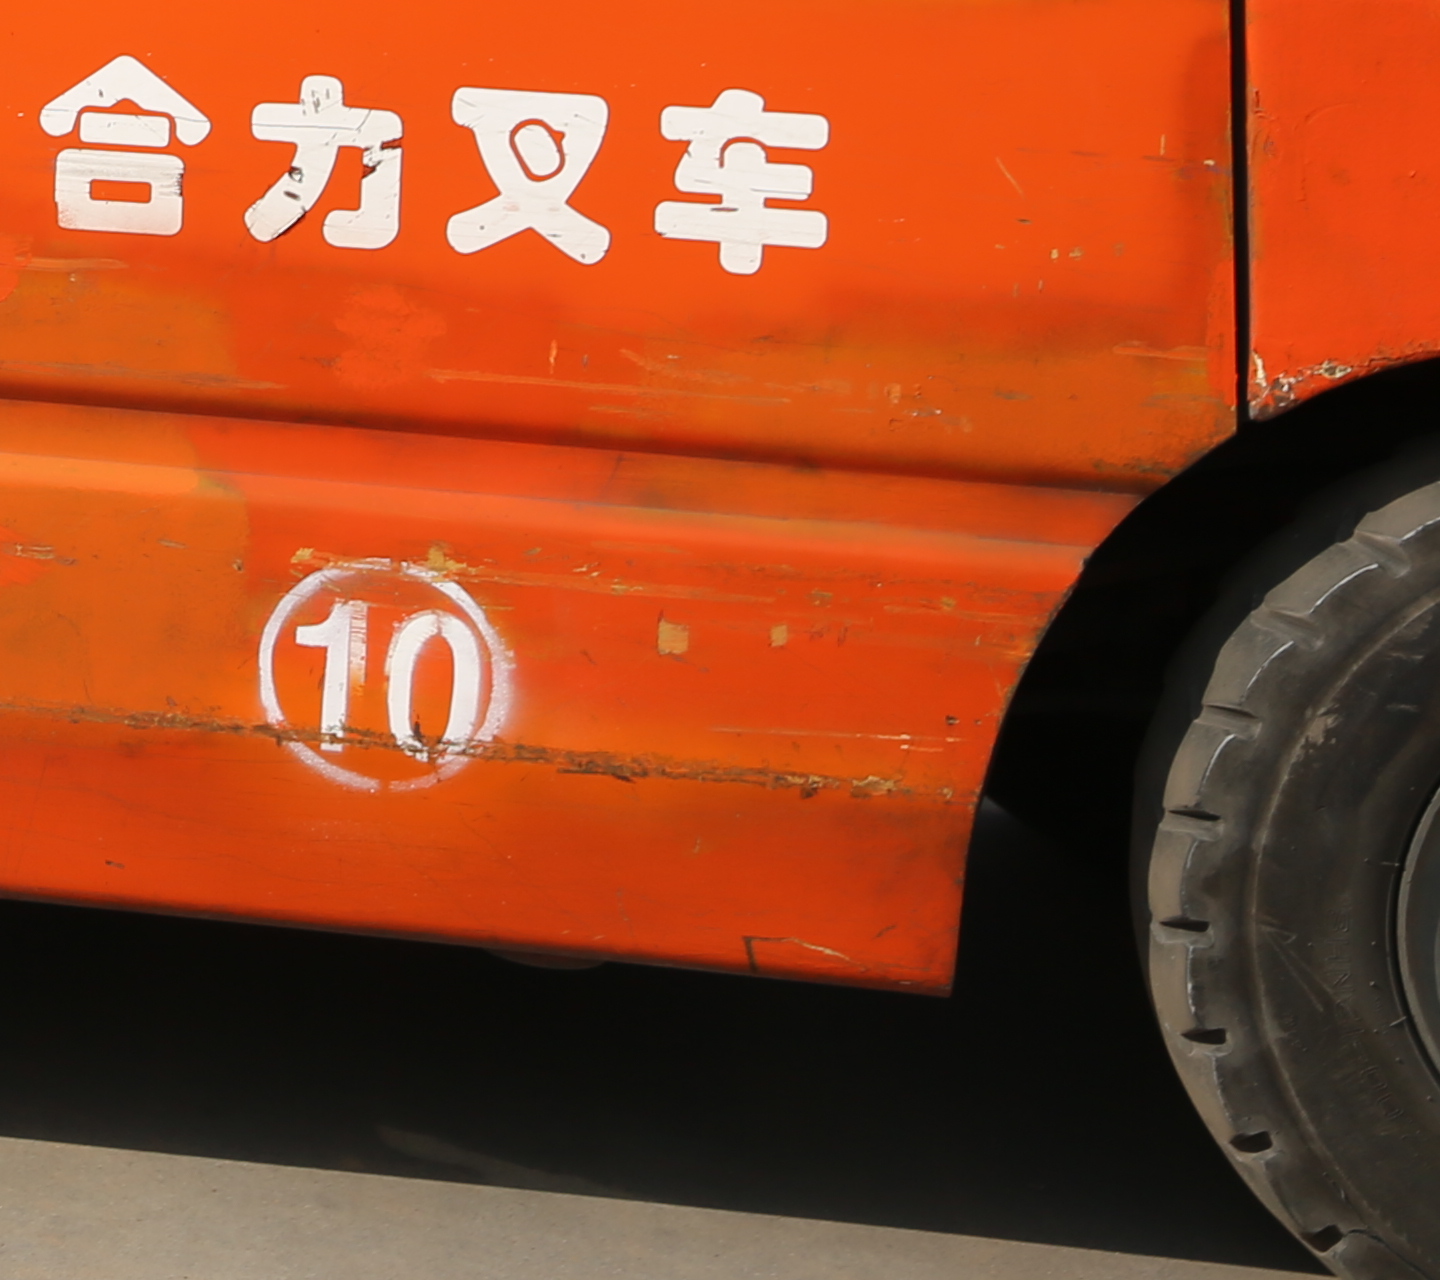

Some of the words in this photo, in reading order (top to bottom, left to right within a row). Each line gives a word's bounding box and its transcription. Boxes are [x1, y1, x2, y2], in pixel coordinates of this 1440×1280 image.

[38, 54, 830, 275] 合力叉车
[295, 597, 481, 764] 10
